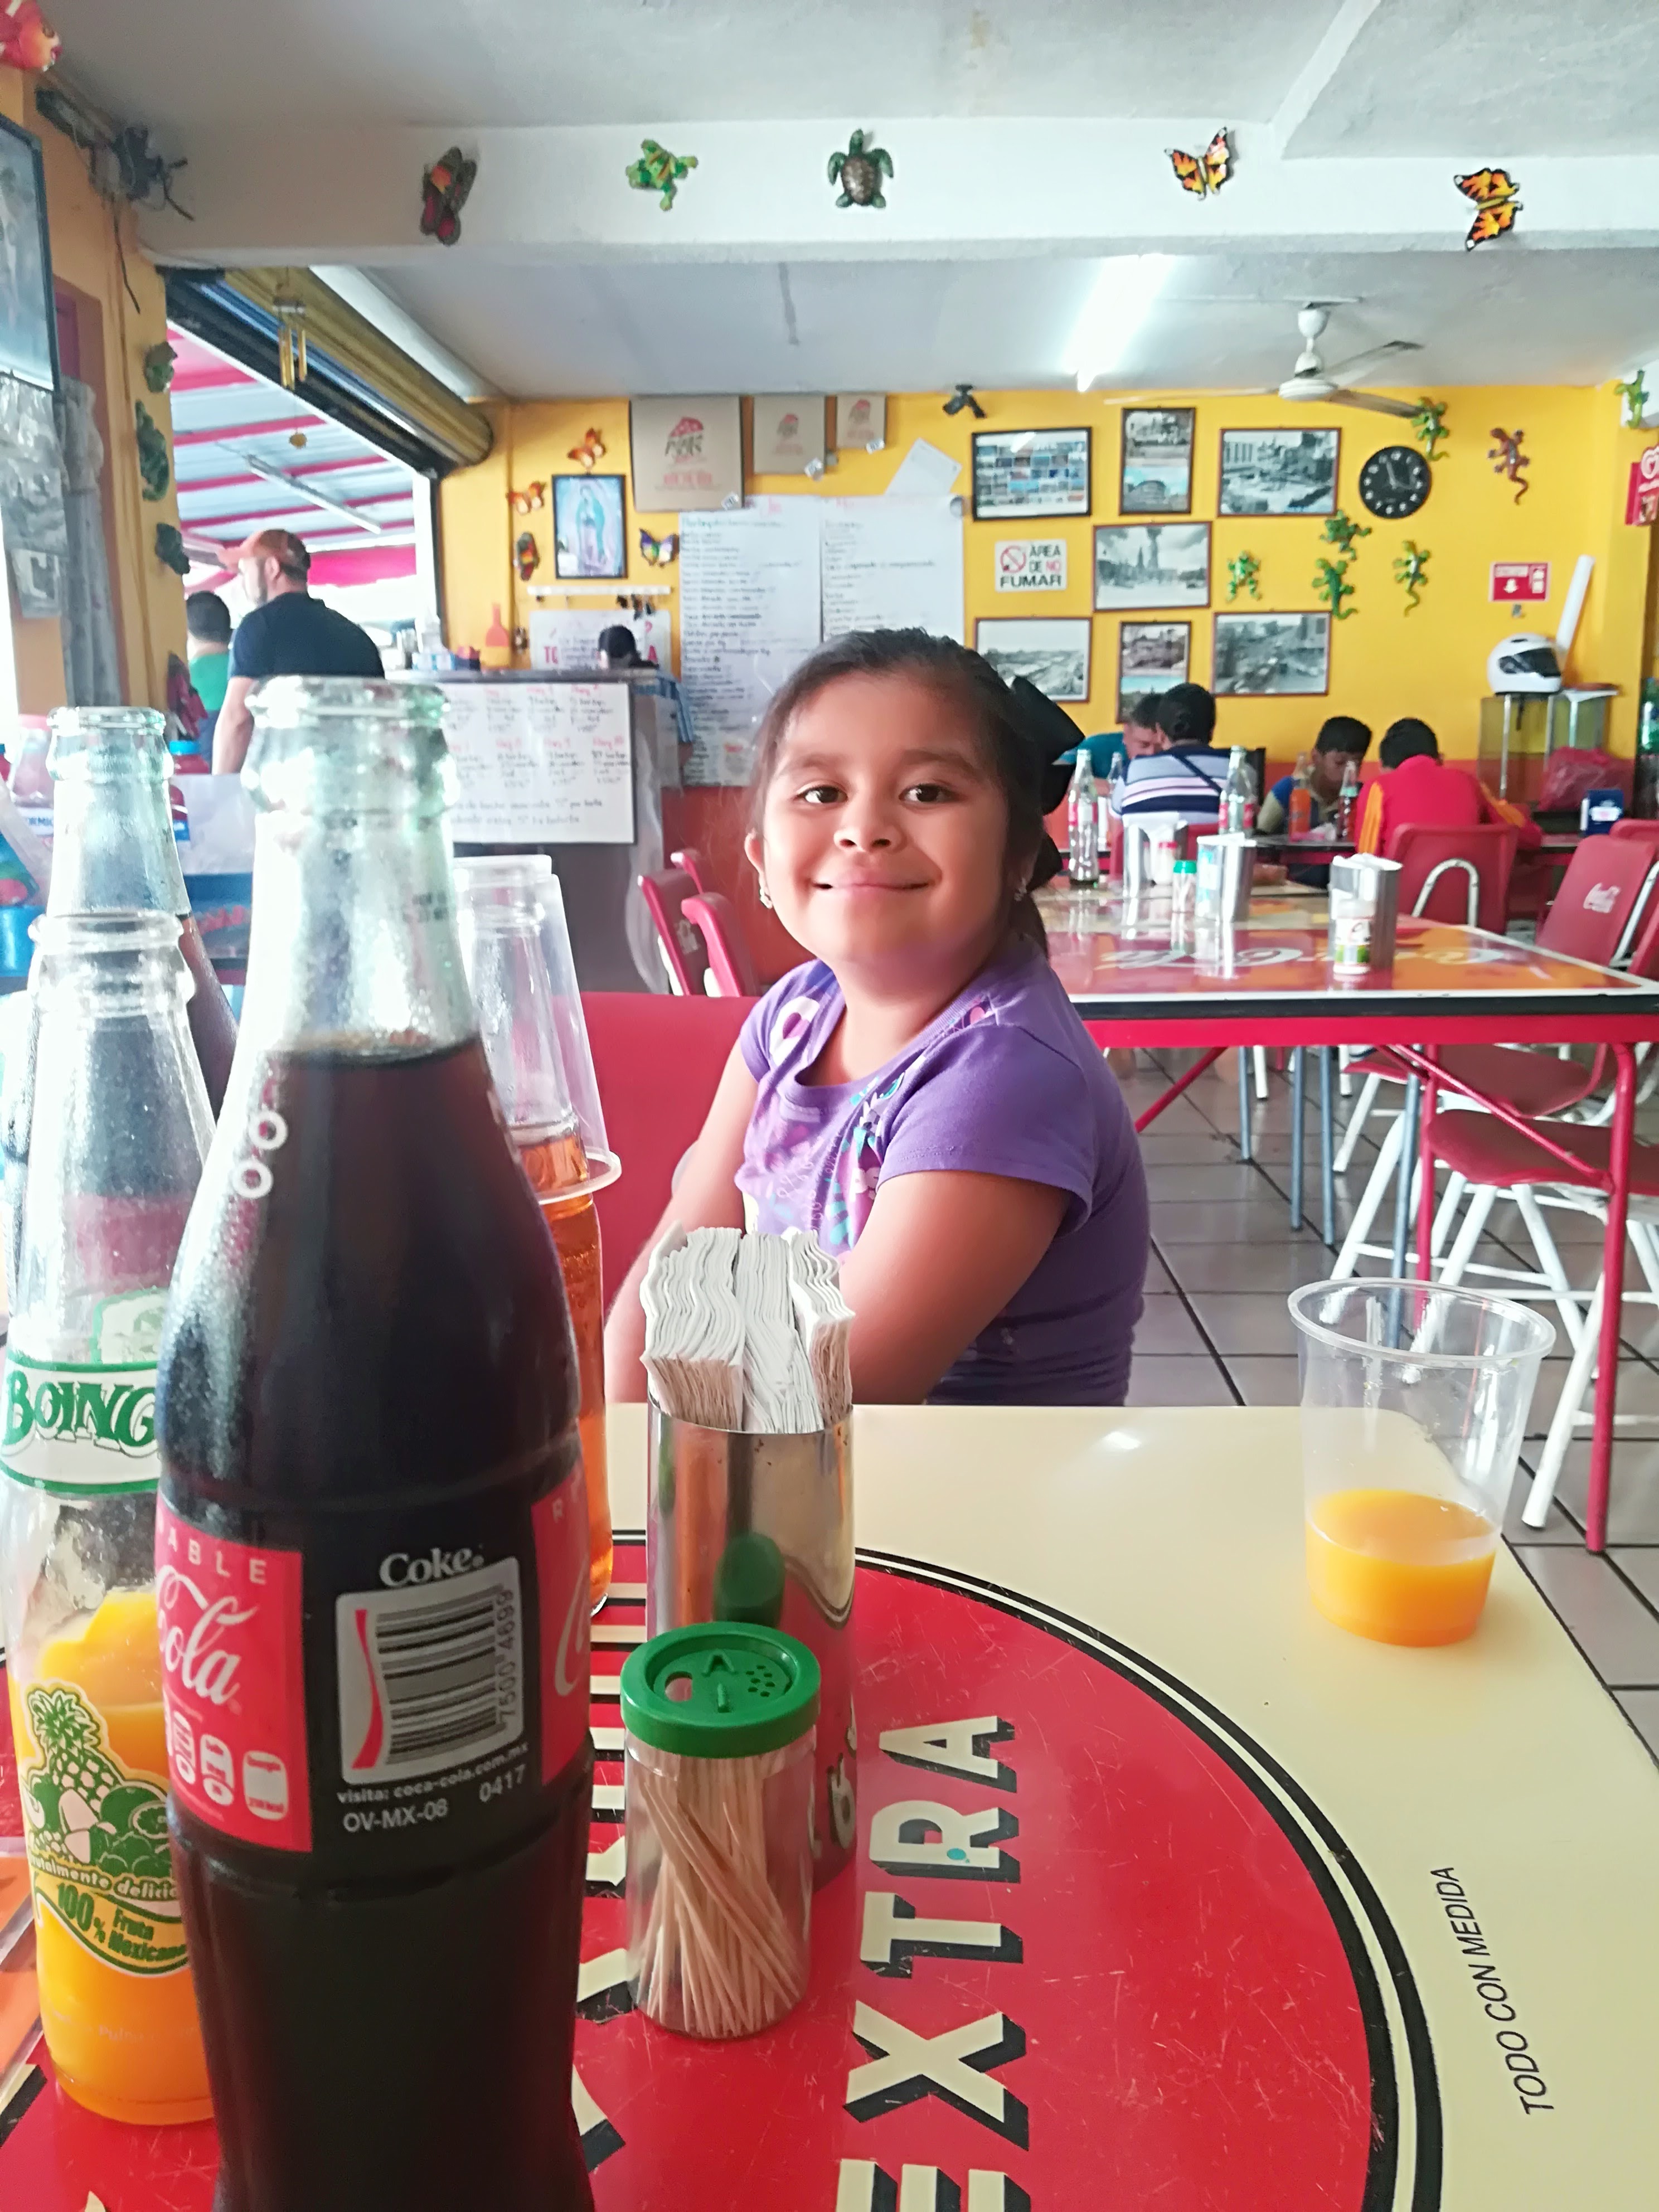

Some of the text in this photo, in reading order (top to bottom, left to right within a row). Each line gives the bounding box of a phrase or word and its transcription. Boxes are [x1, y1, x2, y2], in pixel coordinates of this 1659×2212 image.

[1000, 574, 1061, 588] FUMAR
[479, 1764, 526, 1802] 0417
[1430, 1866, 1554, 2115] TODO CON MEDIDA
